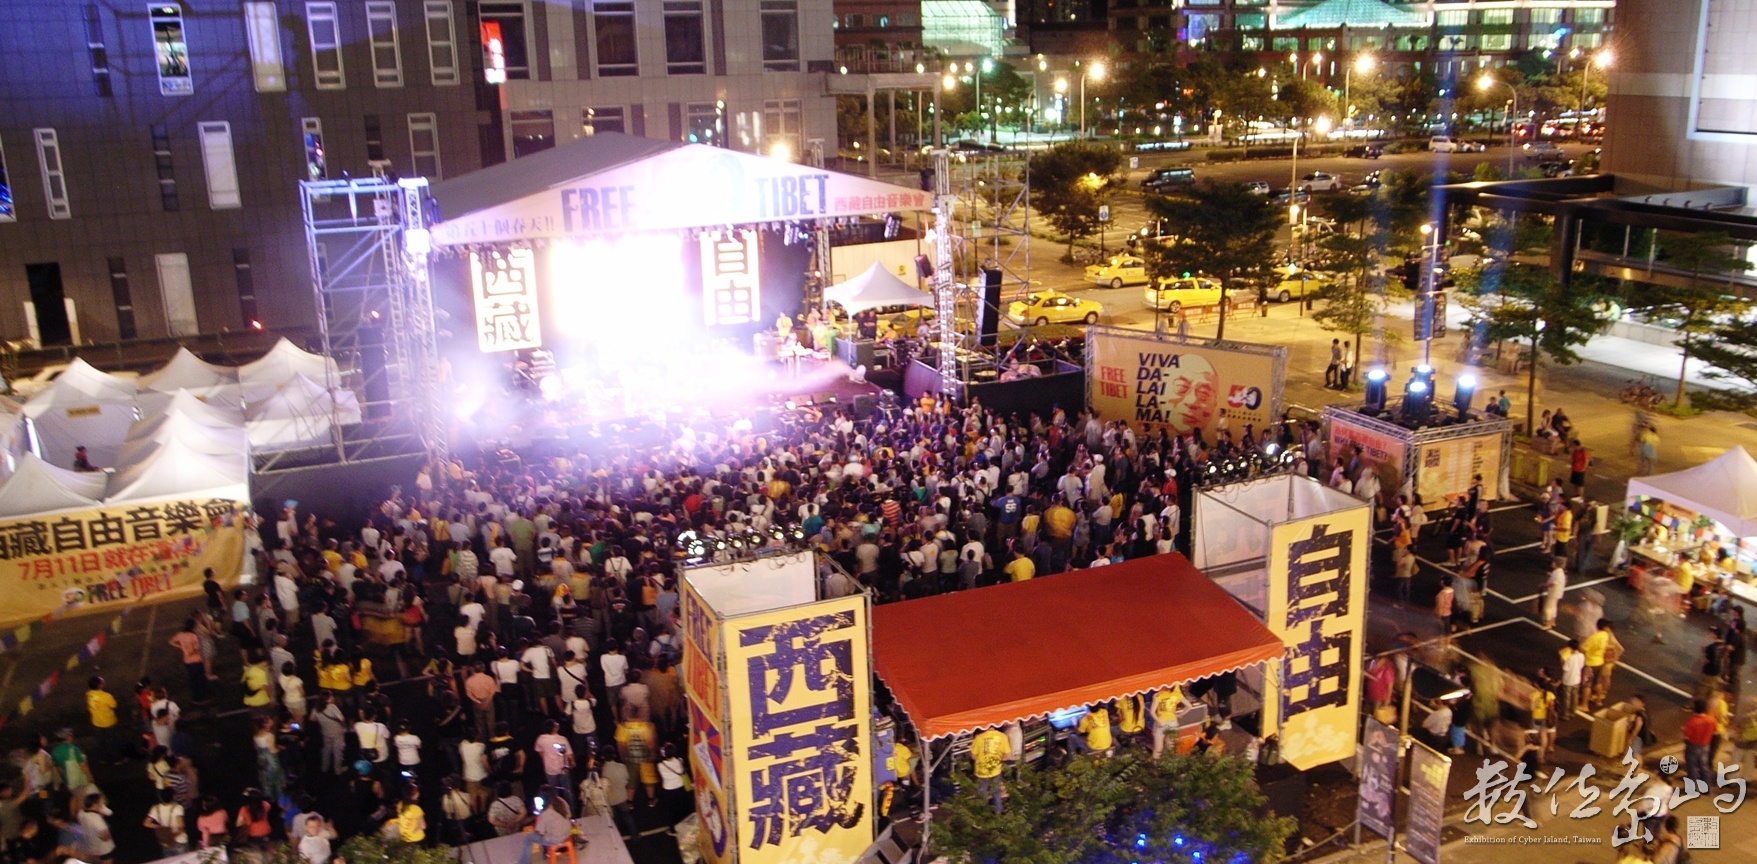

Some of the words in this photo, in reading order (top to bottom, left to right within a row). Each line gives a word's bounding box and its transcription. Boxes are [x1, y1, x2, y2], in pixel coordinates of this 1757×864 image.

[561, 185, 638, 233] FREE
[754, 174, 830, 218] TIBET
[834, 193, 925, 212] 西藏自由音樂會
[712, 228, 752, 319] 自由
[481, 245, 531, 345] 西藏
[1138, 352, 1180, 369] VIVA
[1100, 365, 1126, 384] FREE
[1136, 366, 1170, 382] DA-
[1100, 379, 1128, 399] TIBET
[1136, 381, 1167, 396] LAI
[1135, 395, 1166, 409] LA-
[1135, 408, 1171, 423] MA!
[87, 580, 128, 603] FREE
[1283, 523, 1354, 723] 自由
[739, 609, 866, 851] 西藏
